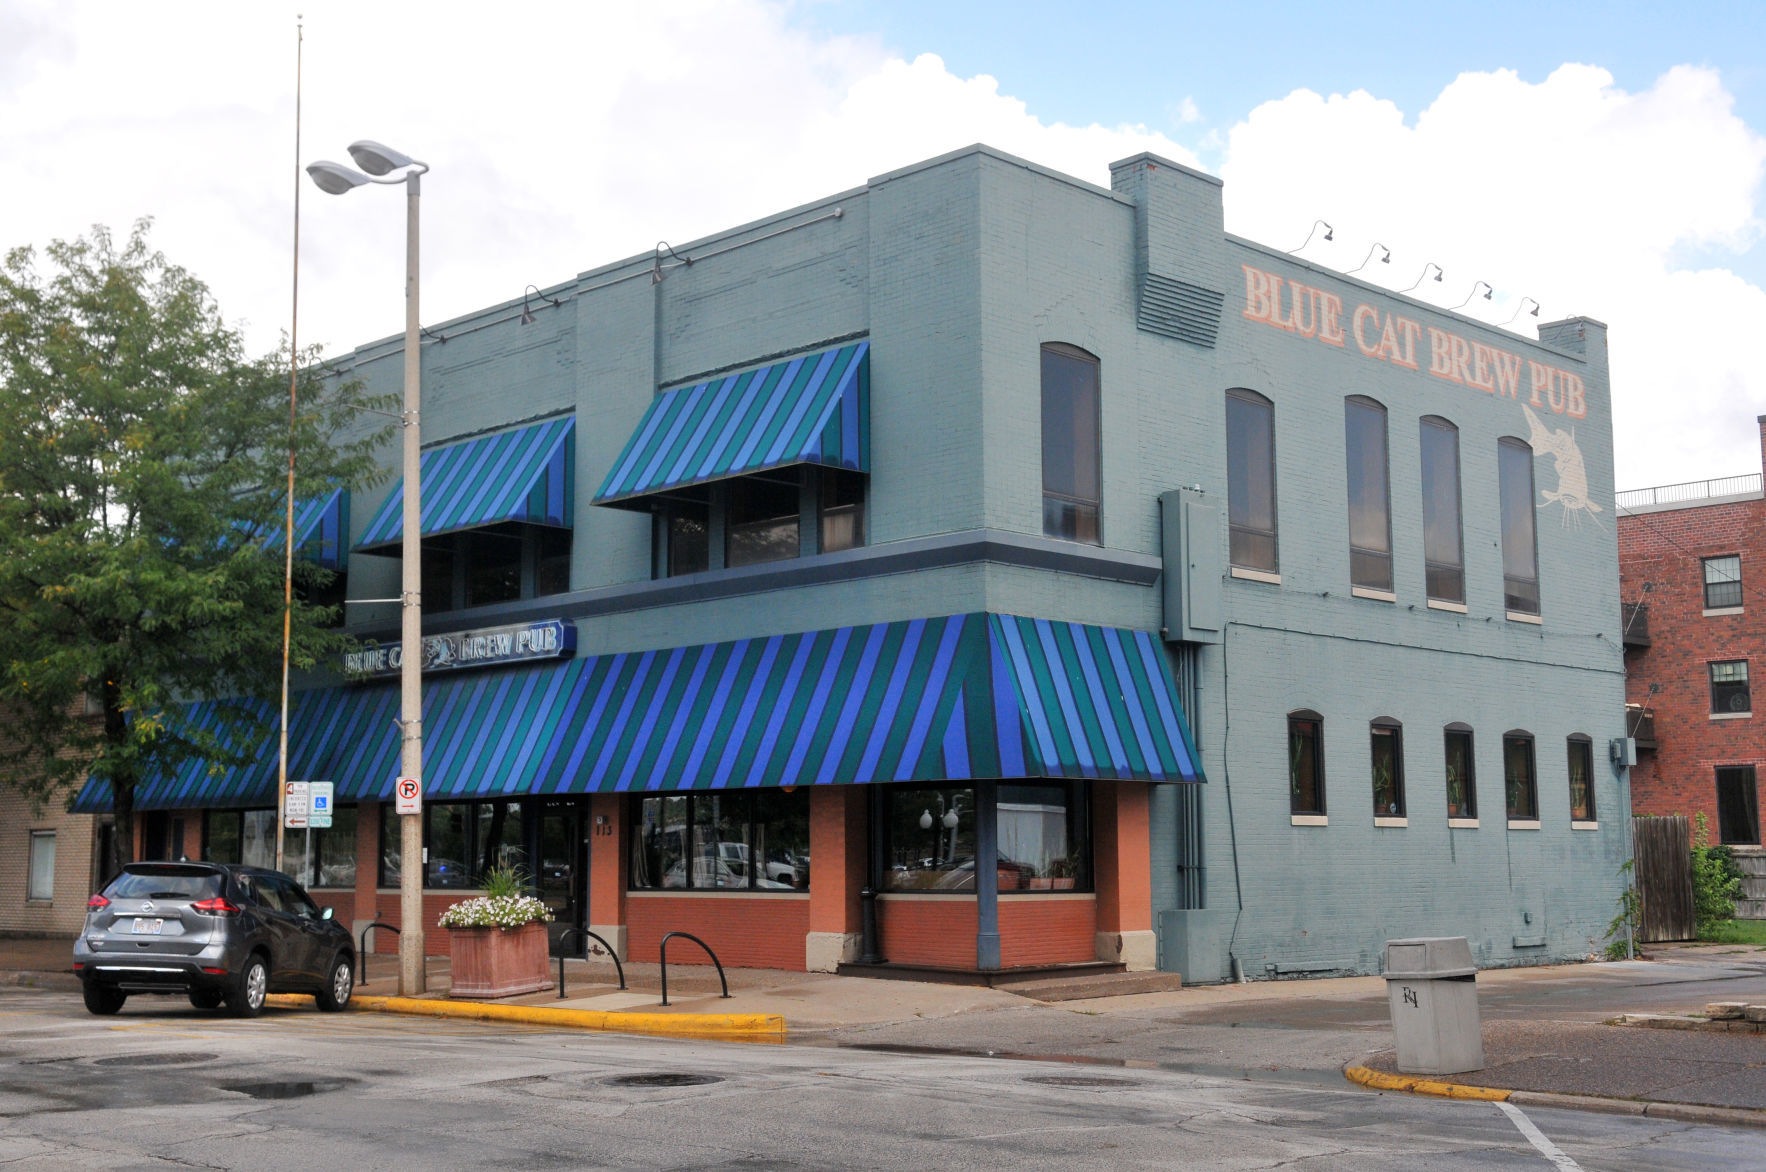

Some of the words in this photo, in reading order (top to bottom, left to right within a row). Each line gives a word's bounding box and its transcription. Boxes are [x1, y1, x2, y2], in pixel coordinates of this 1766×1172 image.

[1242, 264, 1344, 347] BLUE
[1353, 304, 1422, 369] CAT
[1428, 327, 1522, 400] BREW
[1527, 359, 1587, 419] PUB
[343, 648, 387, 673] BLUE
[459, 632, 514, 660] BREW
[516, 626, 557, 654] PUB
